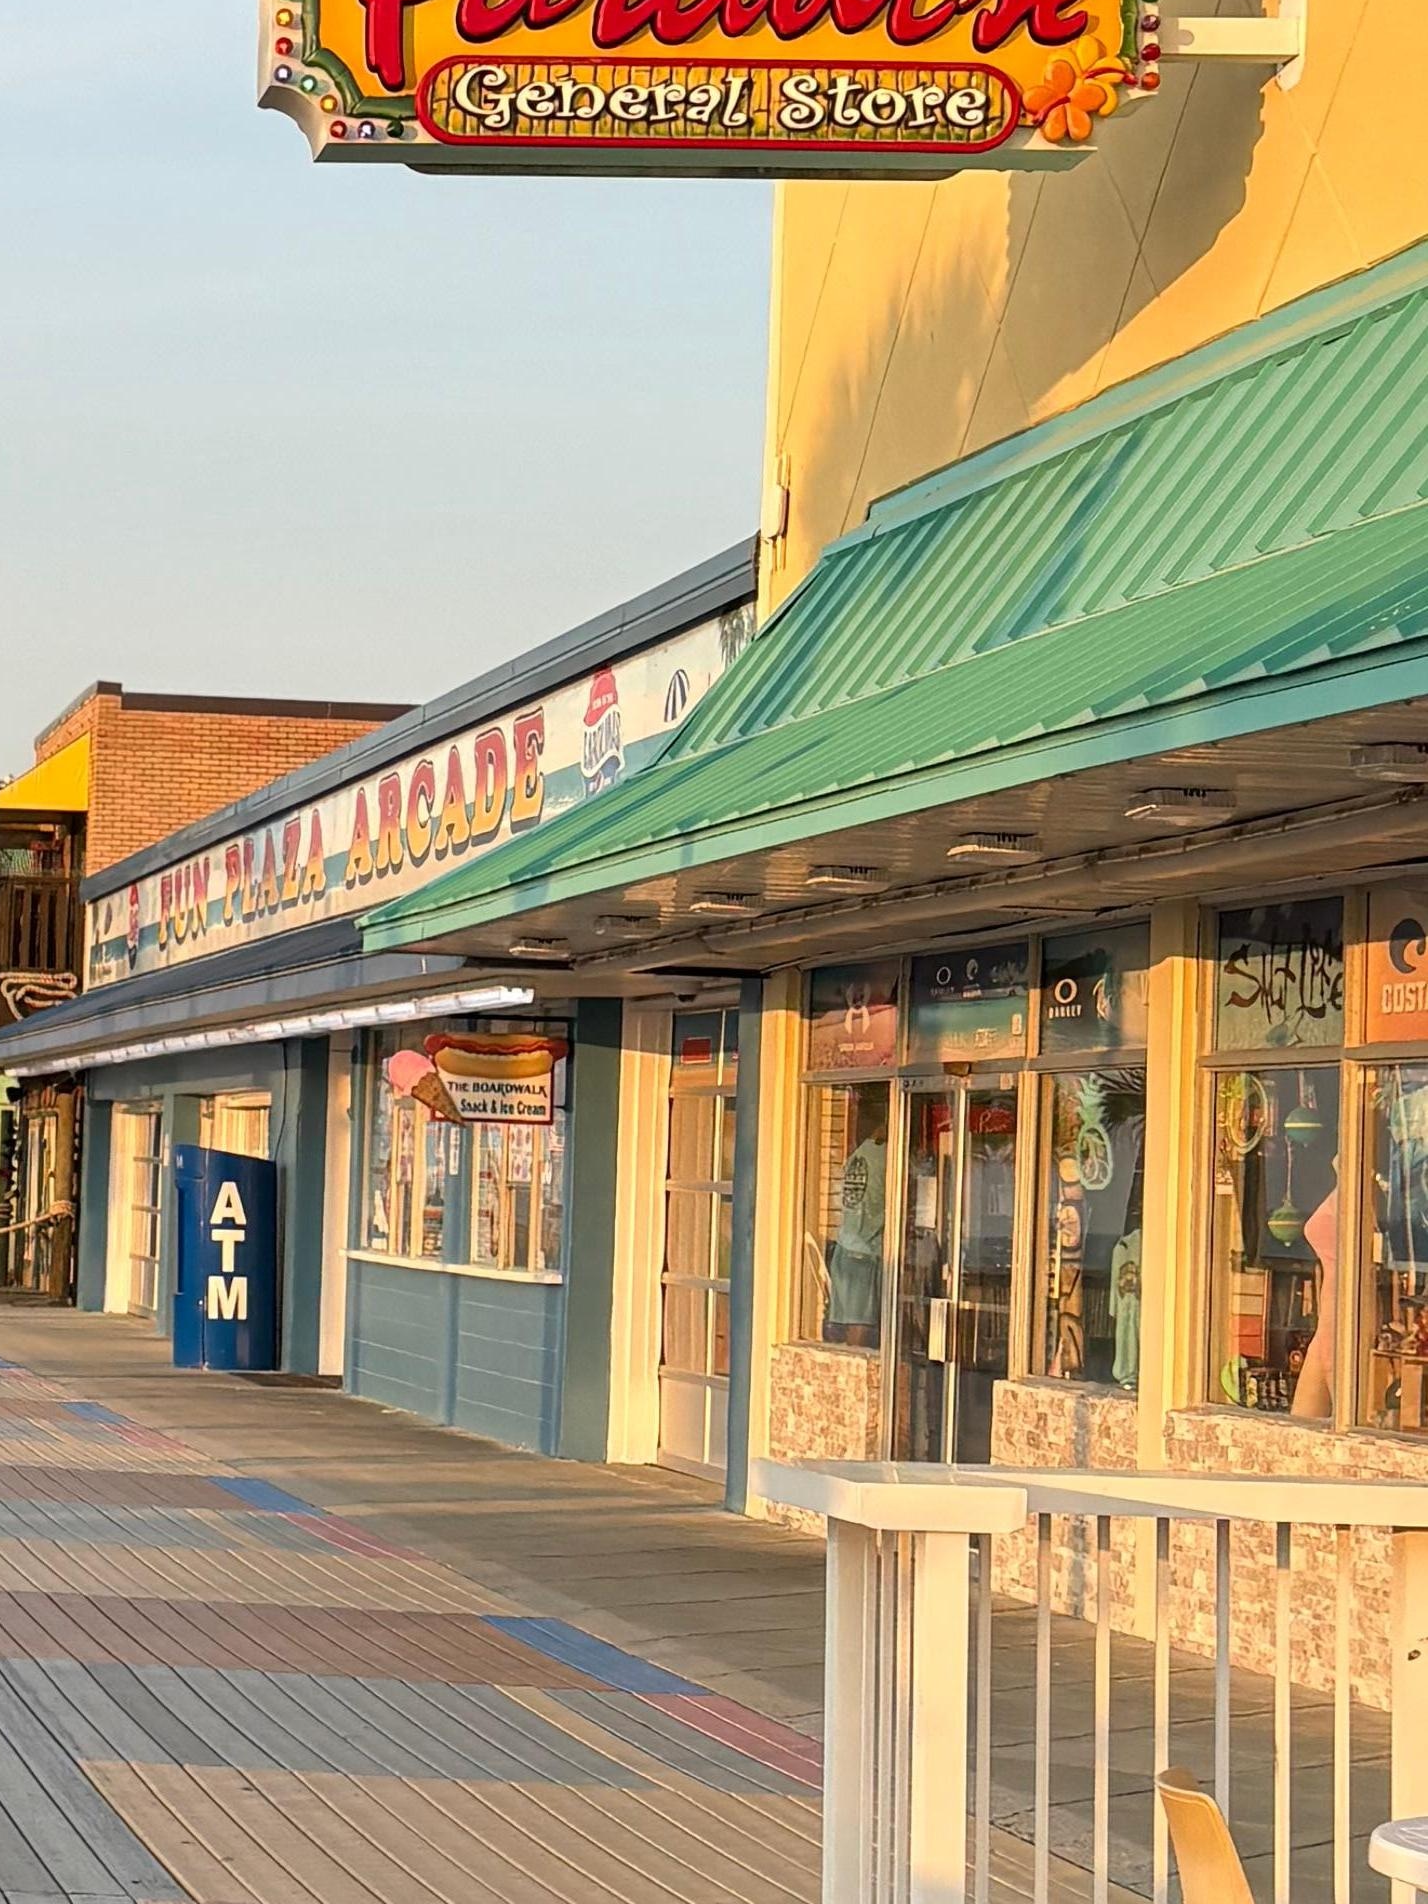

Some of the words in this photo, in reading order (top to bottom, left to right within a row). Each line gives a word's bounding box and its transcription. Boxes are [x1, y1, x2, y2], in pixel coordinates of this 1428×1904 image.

[453, 65, 750, 130] General
[781, 70, 988, 130] Store
[159, 856, 211, 951] FUN
[223, 809, 327, 927] PLAZA
[344, 707, 545, 891] ARCADE
[447, 1081, 469, 1093] THE
[472, 1082, 548, 1098] BOARDWALK
[460, 1098, 488, 1113] Snack
[490, 1100, 498, 1114] &
[499, 1099, 515, 1115] Ice
[516, 1101, 547, 1116] Cream
[207, 1181, 248, 1321] ATM
